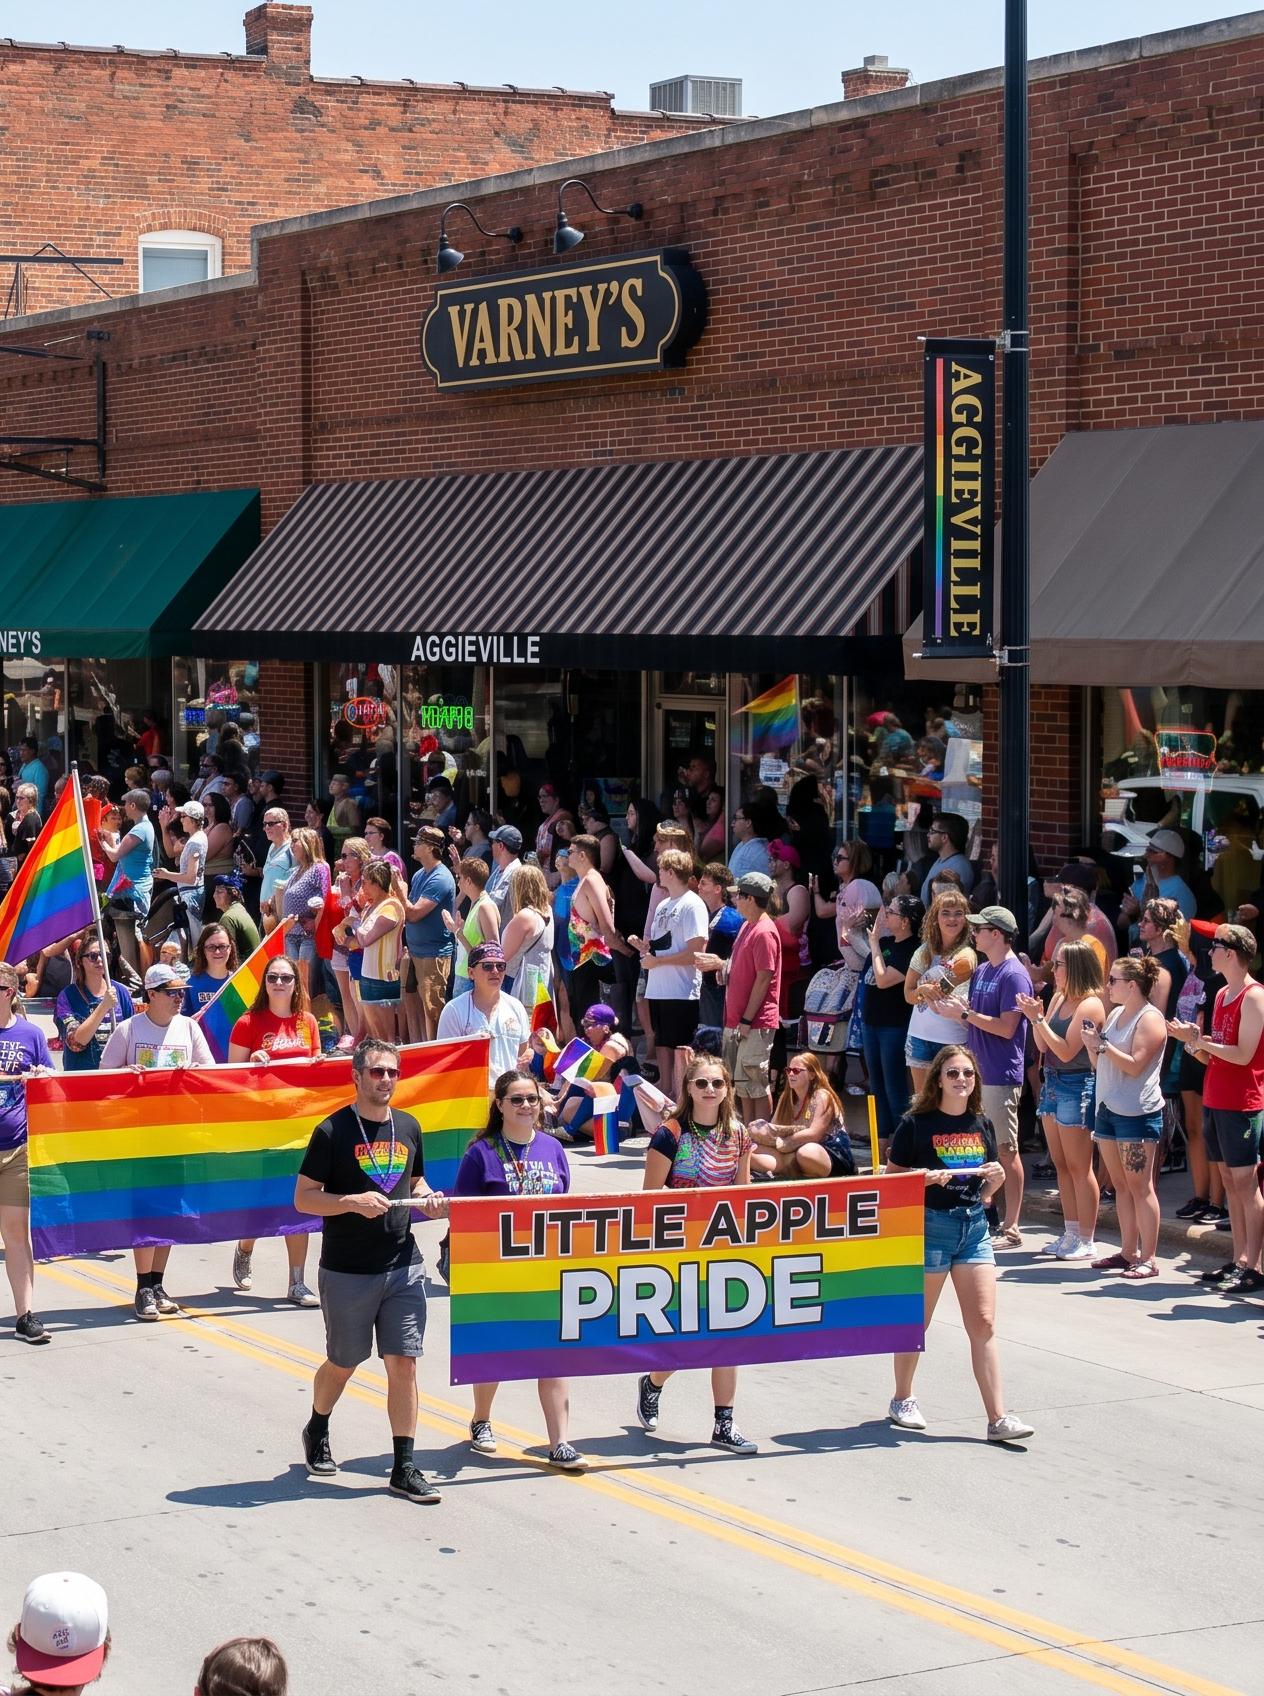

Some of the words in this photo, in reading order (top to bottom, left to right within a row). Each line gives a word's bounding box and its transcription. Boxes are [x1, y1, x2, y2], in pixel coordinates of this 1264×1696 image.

[447, 277, 647, 368] VARNEY'S
[950, 362, 984, 637] AGGIEVILLE
[410, 635, 541, 665] AGGIEVILLE
[498, 1203, 688, 1260] LITTLE
[699, 1190, 880, 1249] APPLE
[559, 1252, 824, 1342] PRIDE
